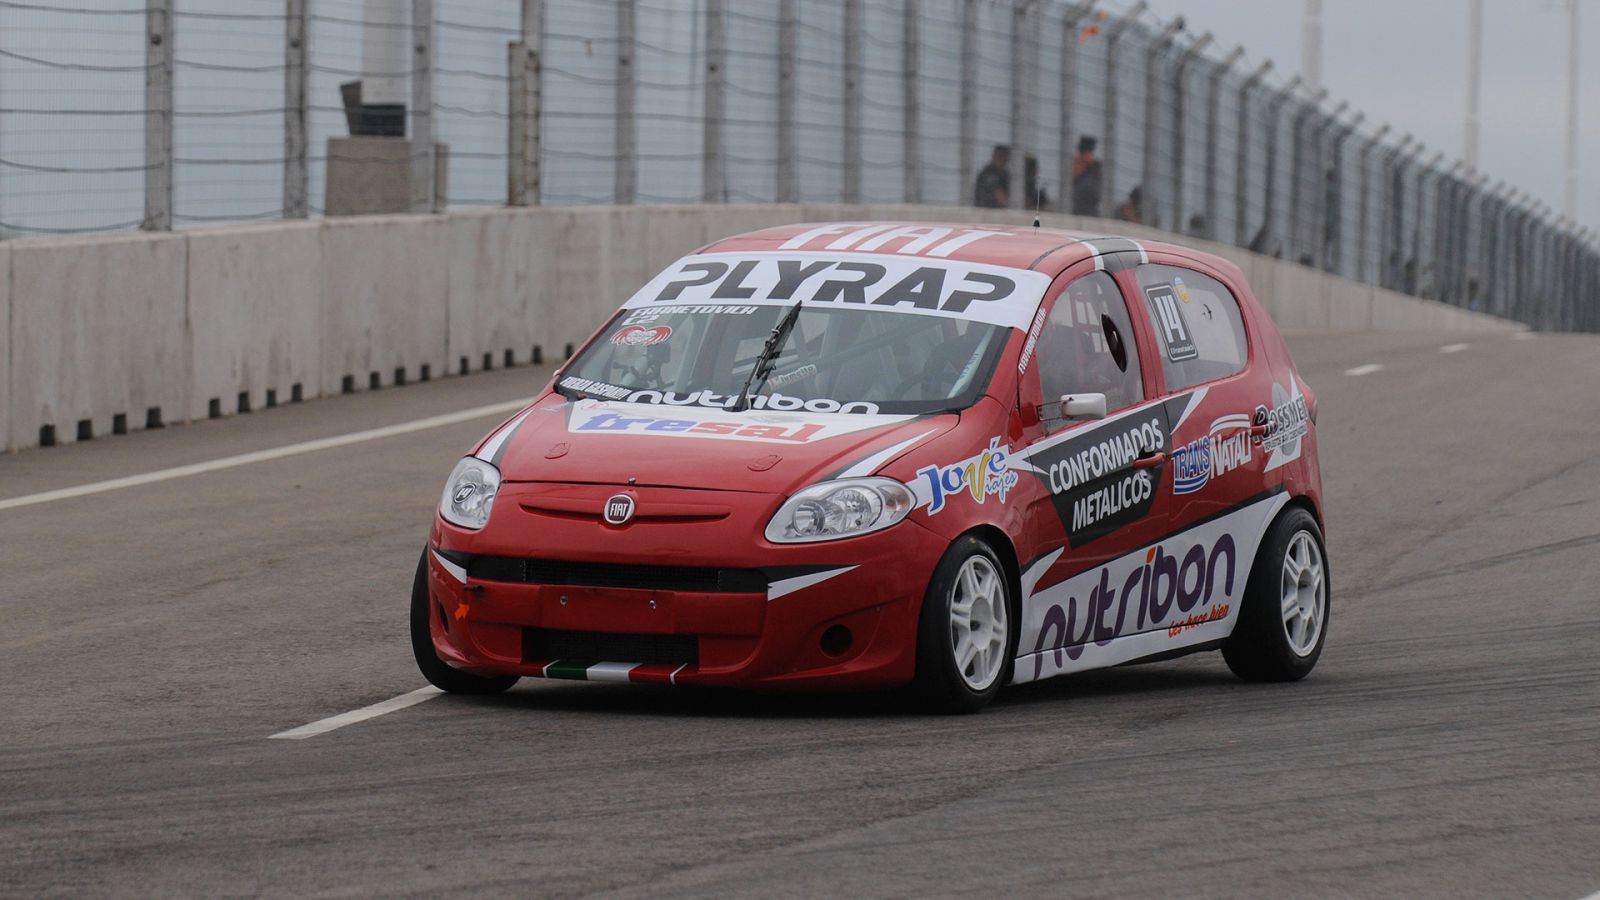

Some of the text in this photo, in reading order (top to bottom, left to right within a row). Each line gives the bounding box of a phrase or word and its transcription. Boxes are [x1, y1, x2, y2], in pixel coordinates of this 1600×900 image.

[778, 224, 1017, 257] FIAT
[653, 260, 1017, 313] PLYRAP
[1154, 294, 1187, 343] 14
[627, 389, 880, 415] nutribon
[577, 413, 826, 442] tresal
[1049, 418, 1164, 495] CONFORMADOS
[1171, 436, 1211, 480] TRANS
[609, 503, 629, 517] FIAT
[1072, 469, 1152, 532] METALICOS
[1034, 533, 1236, 680] nutribon
